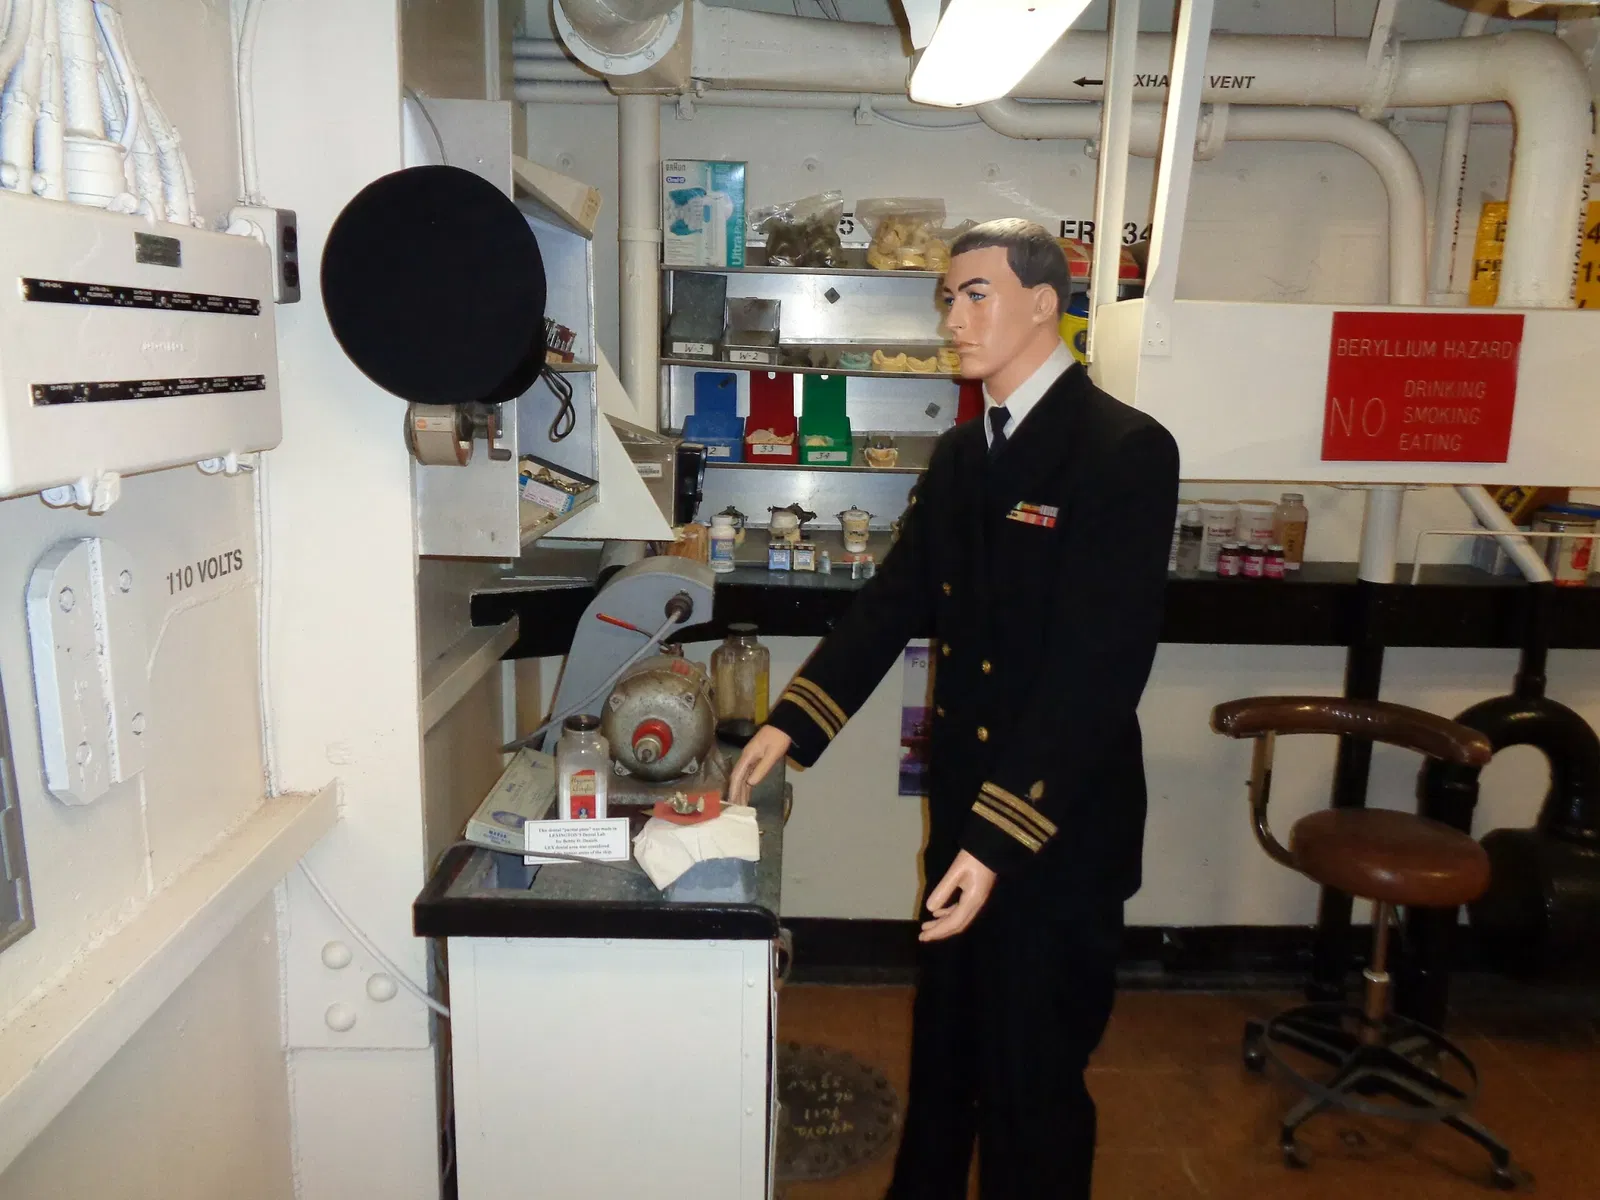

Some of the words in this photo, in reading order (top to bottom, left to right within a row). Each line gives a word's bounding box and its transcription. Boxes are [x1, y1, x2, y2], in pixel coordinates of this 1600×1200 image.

[1210, 76, 1256, 89] VENT
[684, 344, 704, 353] W-3
[739, 352, 758, 360] W-2
[1337, 338, 1437, 358] BERYLLIUM
[1443, 340, 1512, 360] HAZARD
[1403, 379, 1487, 400] DRINKING
[1330, 397, 1386, 437] NO
[1403, 406, 1481, 425] SMOKING
[1399, 433, 1463, 451] EATING
[166, 565, 193, 595] 110
[197, 549, 243, 583] VOLTS
